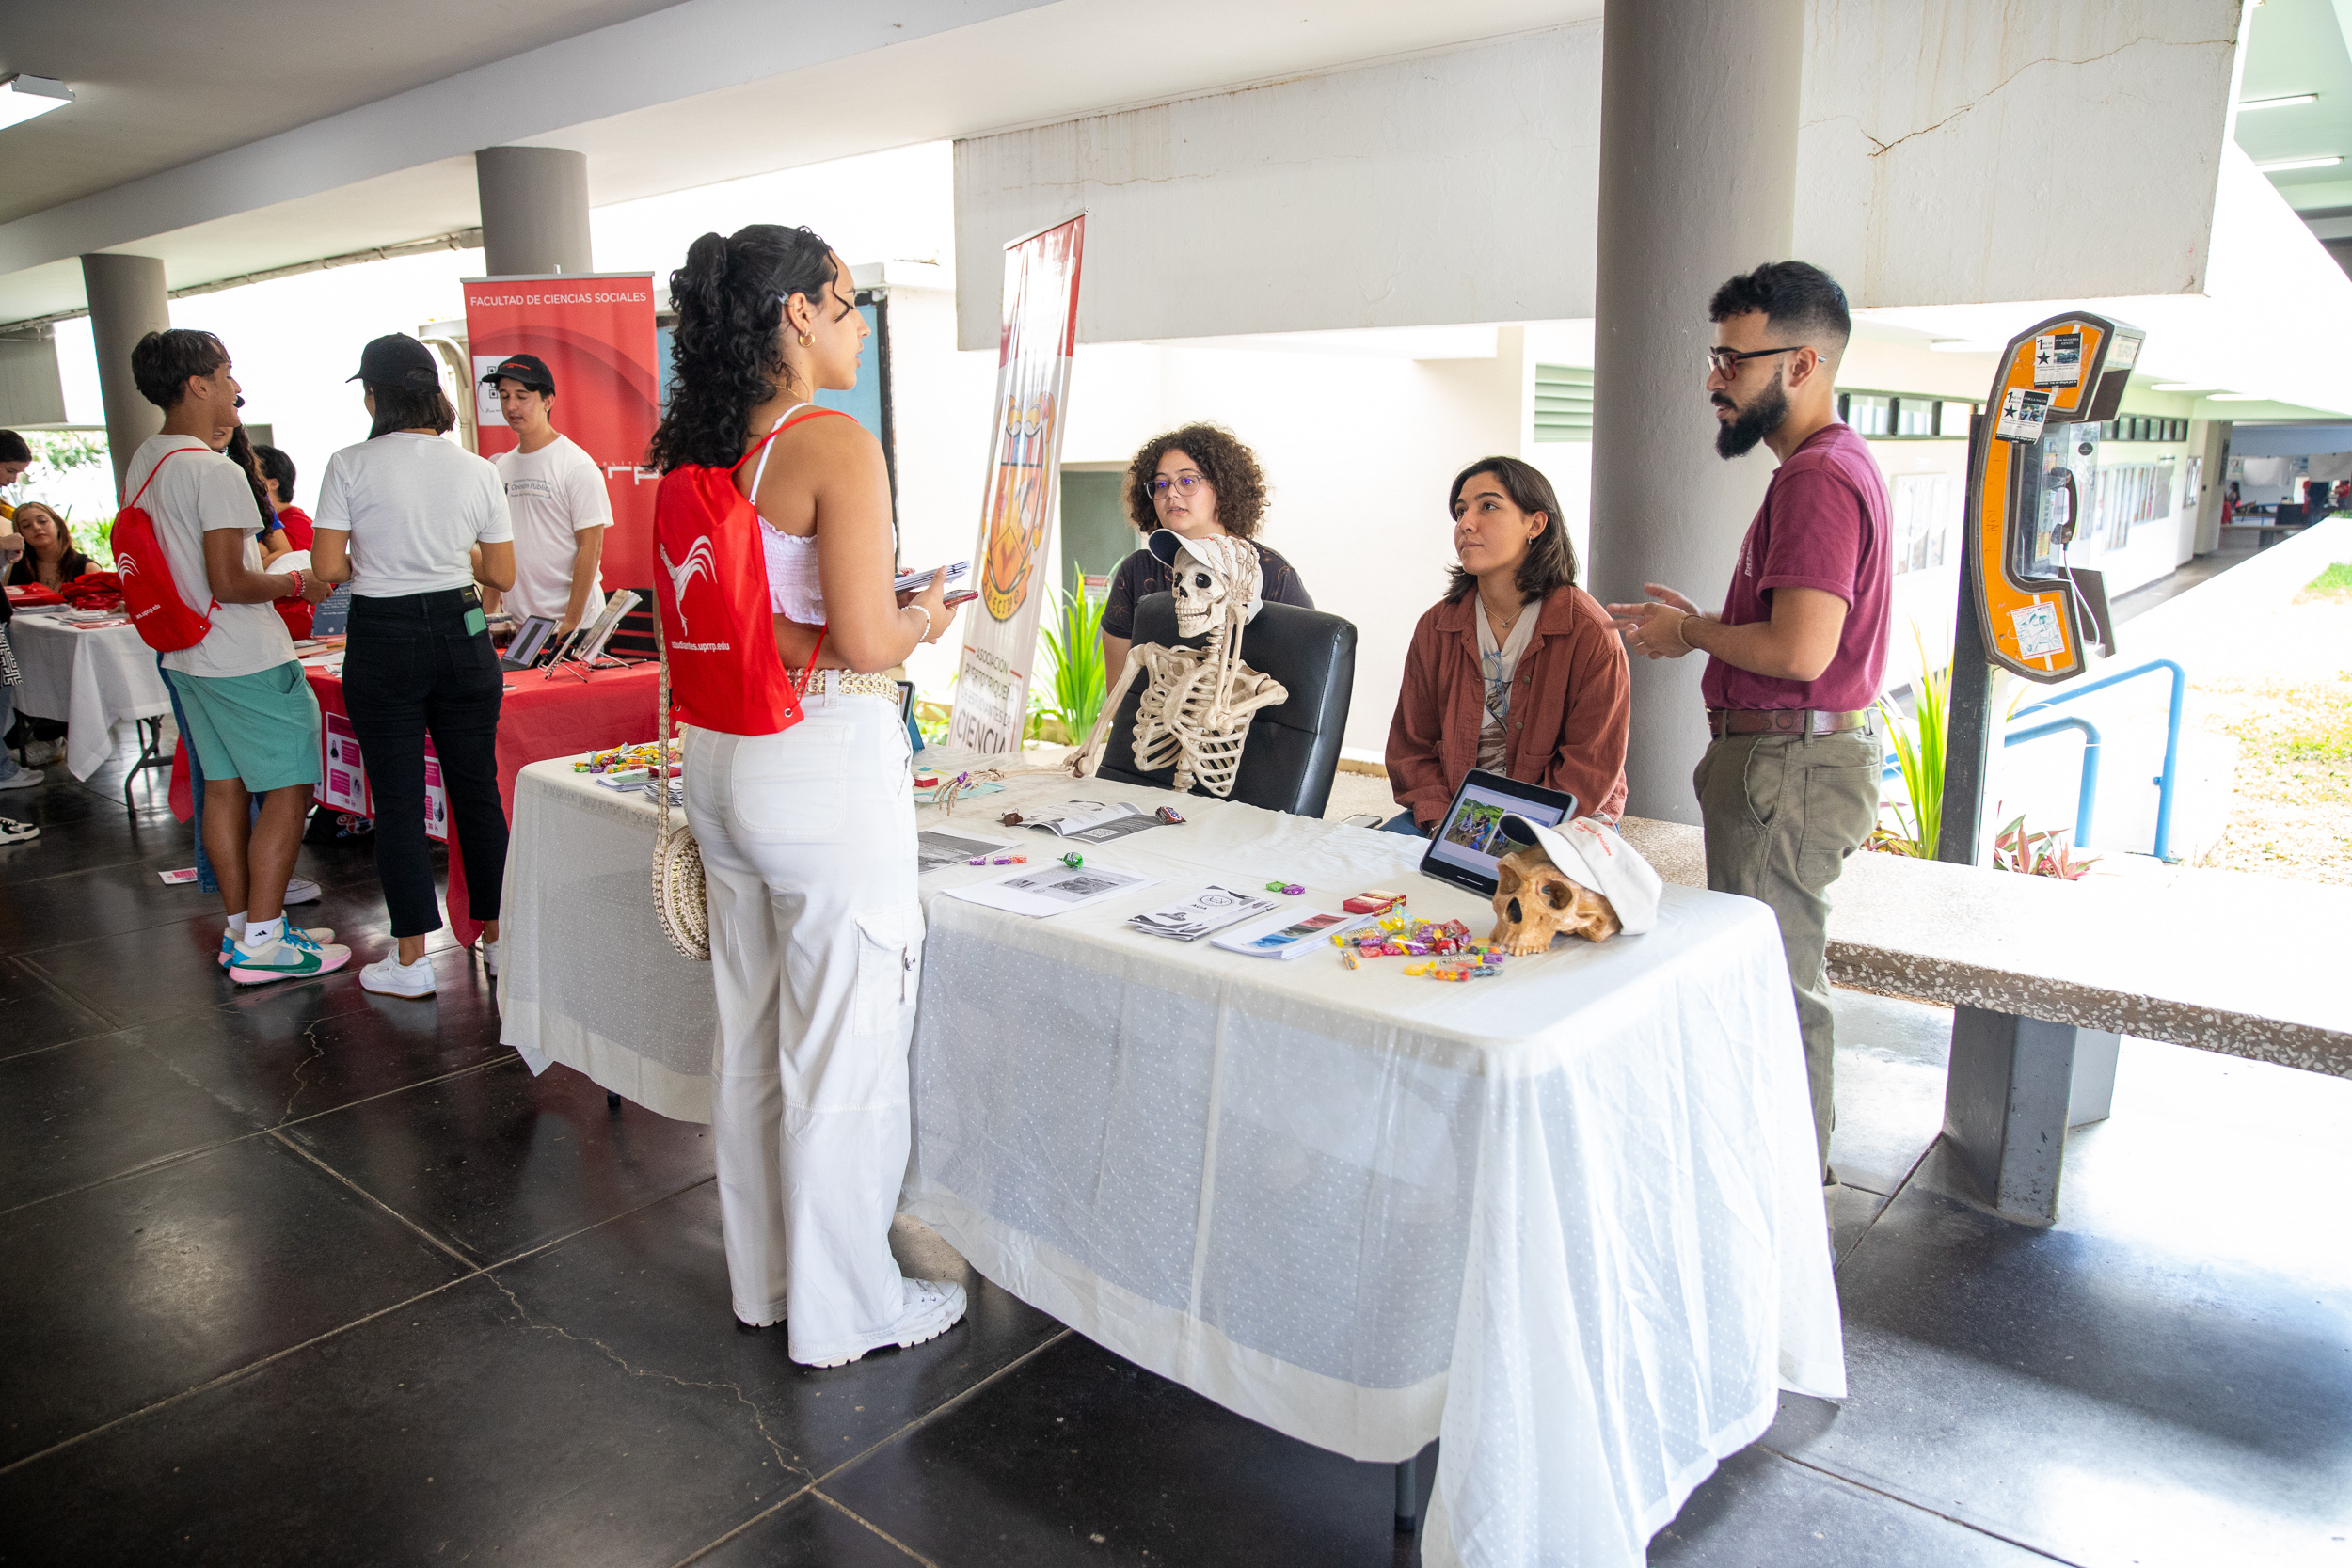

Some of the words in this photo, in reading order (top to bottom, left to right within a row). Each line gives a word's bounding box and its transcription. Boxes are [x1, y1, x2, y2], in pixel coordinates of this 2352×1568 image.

[470, 294, 524, 307] FACULTAD
[526, 293, 541, 305] DE
[543, 293, 592, 305] CIENCIAS
[594, 292, 647, 303] SOCIALES
[976, 646, 1009, 675] ASOCIACIÓN
